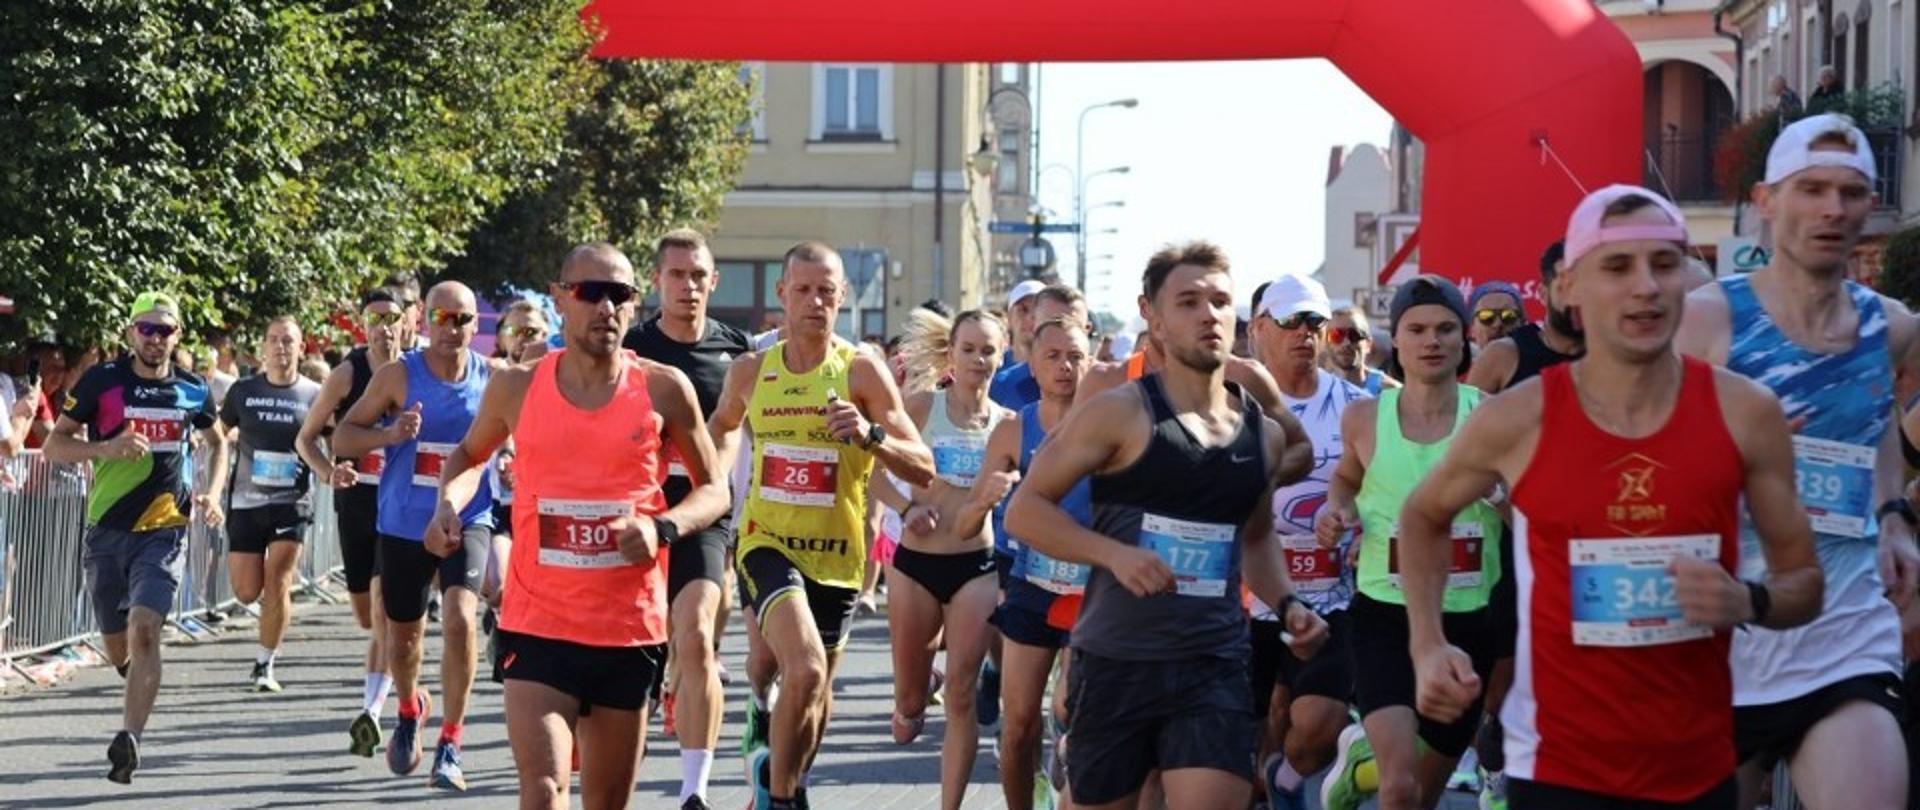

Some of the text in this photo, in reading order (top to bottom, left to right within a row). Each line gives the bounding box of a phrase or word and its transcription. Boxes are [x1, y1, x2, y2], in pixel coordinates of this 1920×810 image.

[245, 397, 275, 408] DMG
[257, 411, 295, 424] TEAM
[141, 423, 168, 438] 115
[784, 466, 810, 486] 26
[566, 524, 609, 545] 130
[1167, 546, 1211, 571] 177
[1292, 556, 1316, 573] 59
[1047, 560, 1080, 579] 183
[1614, 577, 1678, 611] 342
